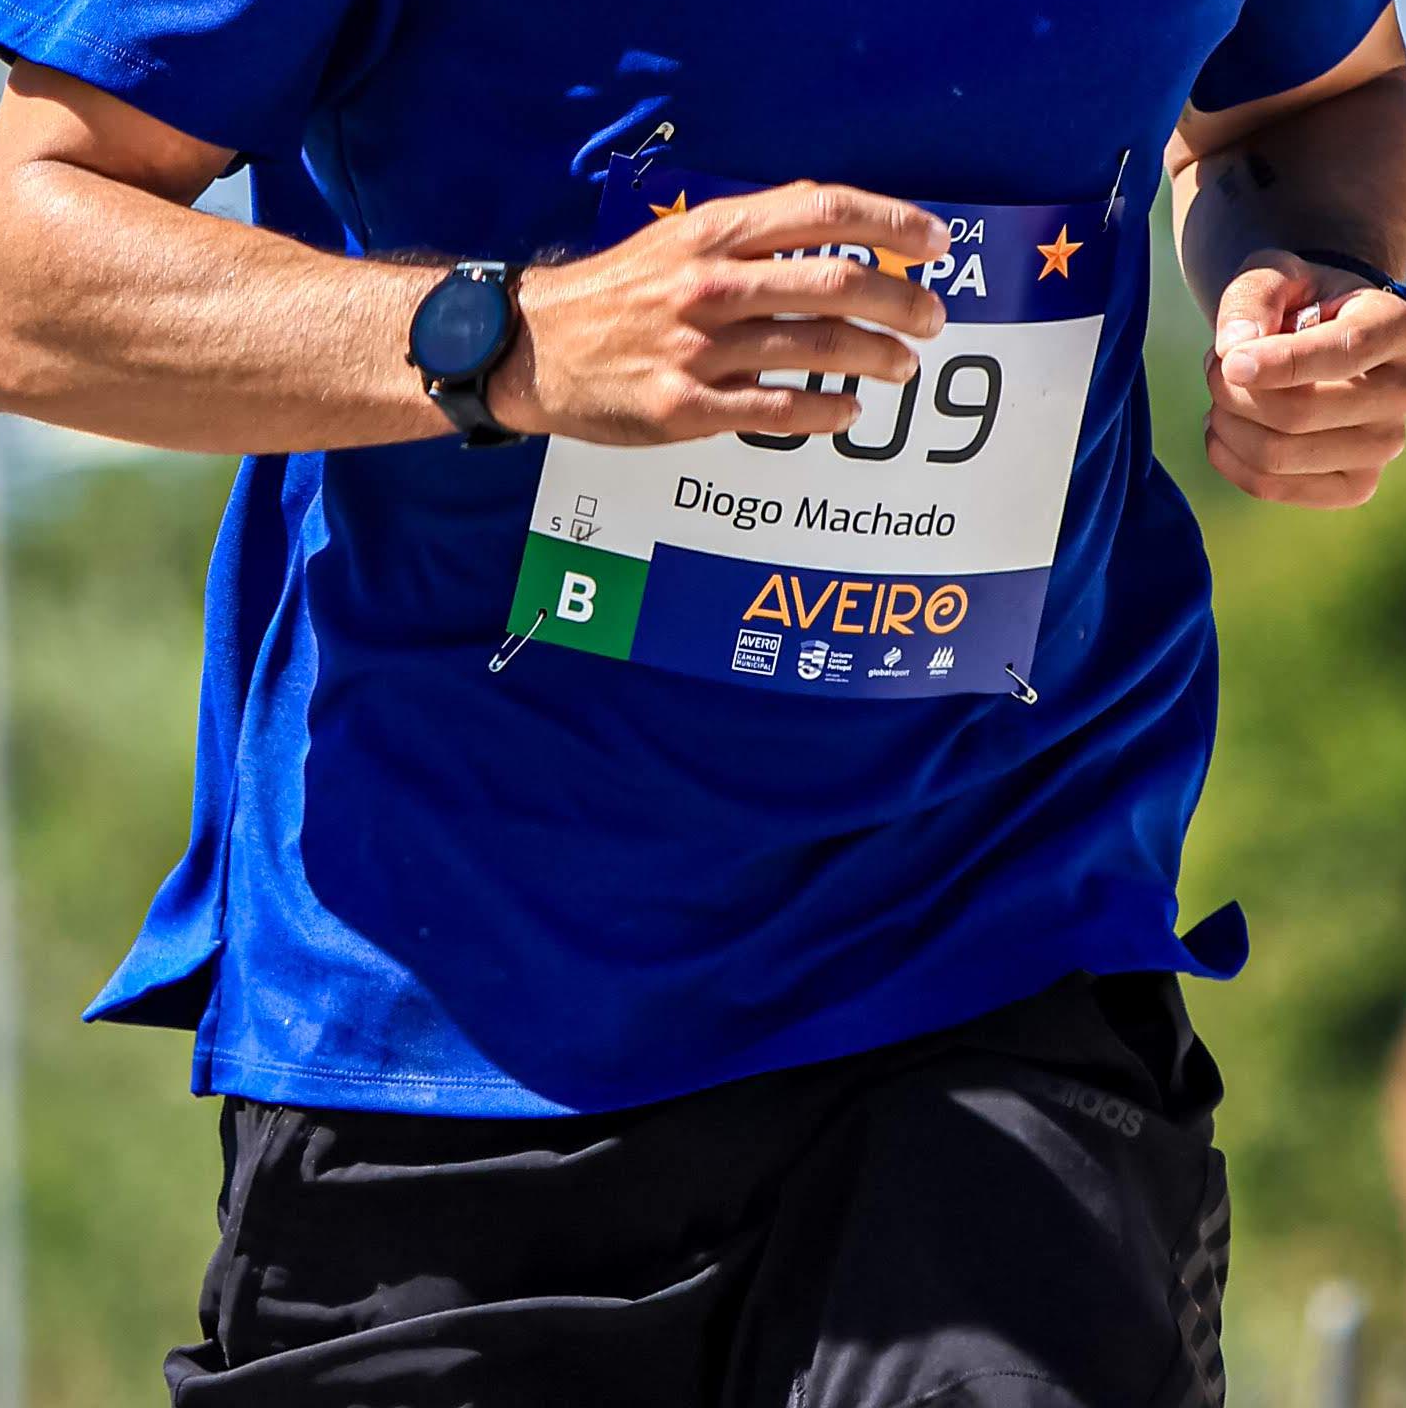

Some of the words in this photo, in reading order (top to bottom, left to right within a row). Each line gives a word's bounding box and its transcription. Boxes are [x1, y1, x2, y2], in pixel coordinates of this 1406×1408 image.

[947, 217, 985, 245] DA
[550, 515, 563, 532] S
[673, 476, 783, 531] Diogo
[793, 496, 956, 537] Machado
[555, 570, 597, 623] B
[742, 574, 969, 635] AVEIRO
[739, 634, 778, 651] AVEIRO
